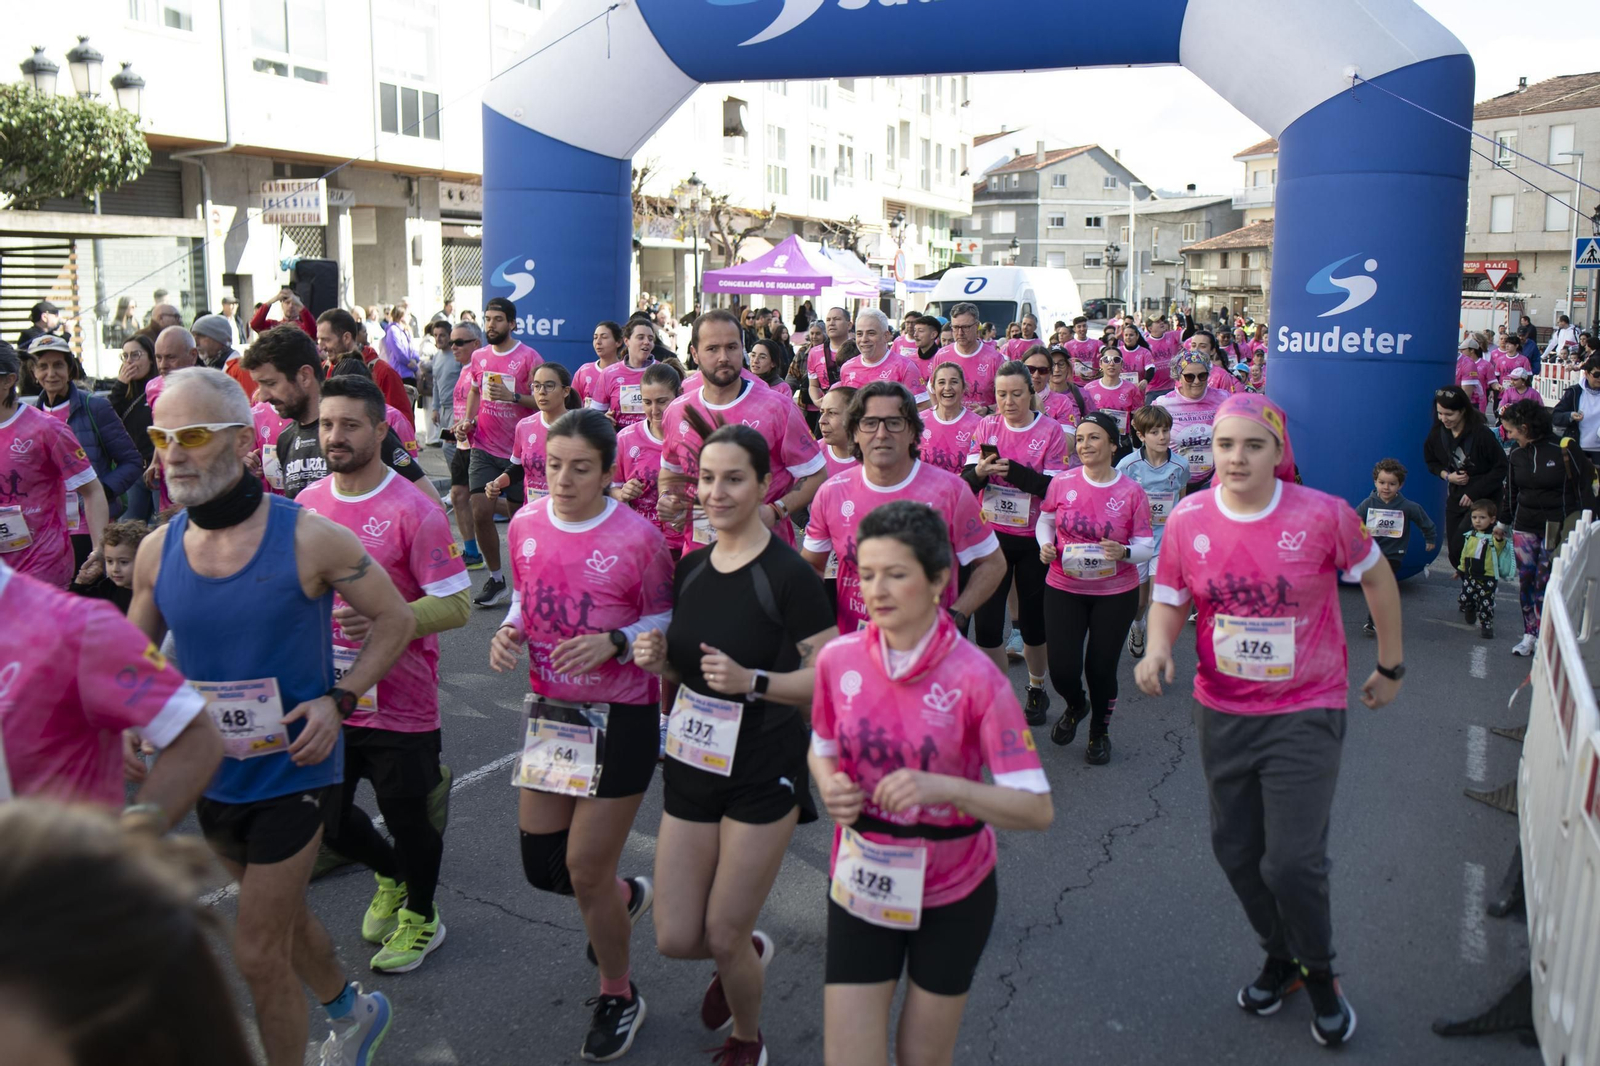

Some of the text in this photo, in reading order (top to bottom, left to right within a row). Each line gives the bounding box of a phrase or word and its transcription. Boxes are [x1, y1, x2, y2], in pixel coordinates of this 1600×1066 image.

[262, 212, 321, 225] CHARCUTERIA
[718, 279, 764, 289] CONCELLERÍA
[777, 282, 816, 290] IGUALDADE
[1277, 325, 1413, 355] Saudeter
[1190, 454, 1205, 462] 174
[1000, 499, 1014, 511] 32
[1151, 503, 1164, 512] 62
[1378, 519, 1395, 527] 209
[1084, 557, 1099, 567] 36
[1241, 639, 1272, 655] 176
[222, 709, 248, 727] 48
[686, 716, 713, 739] 177
[553, 746, 574, 763] 64
[856, 866, 893, 893] 178
